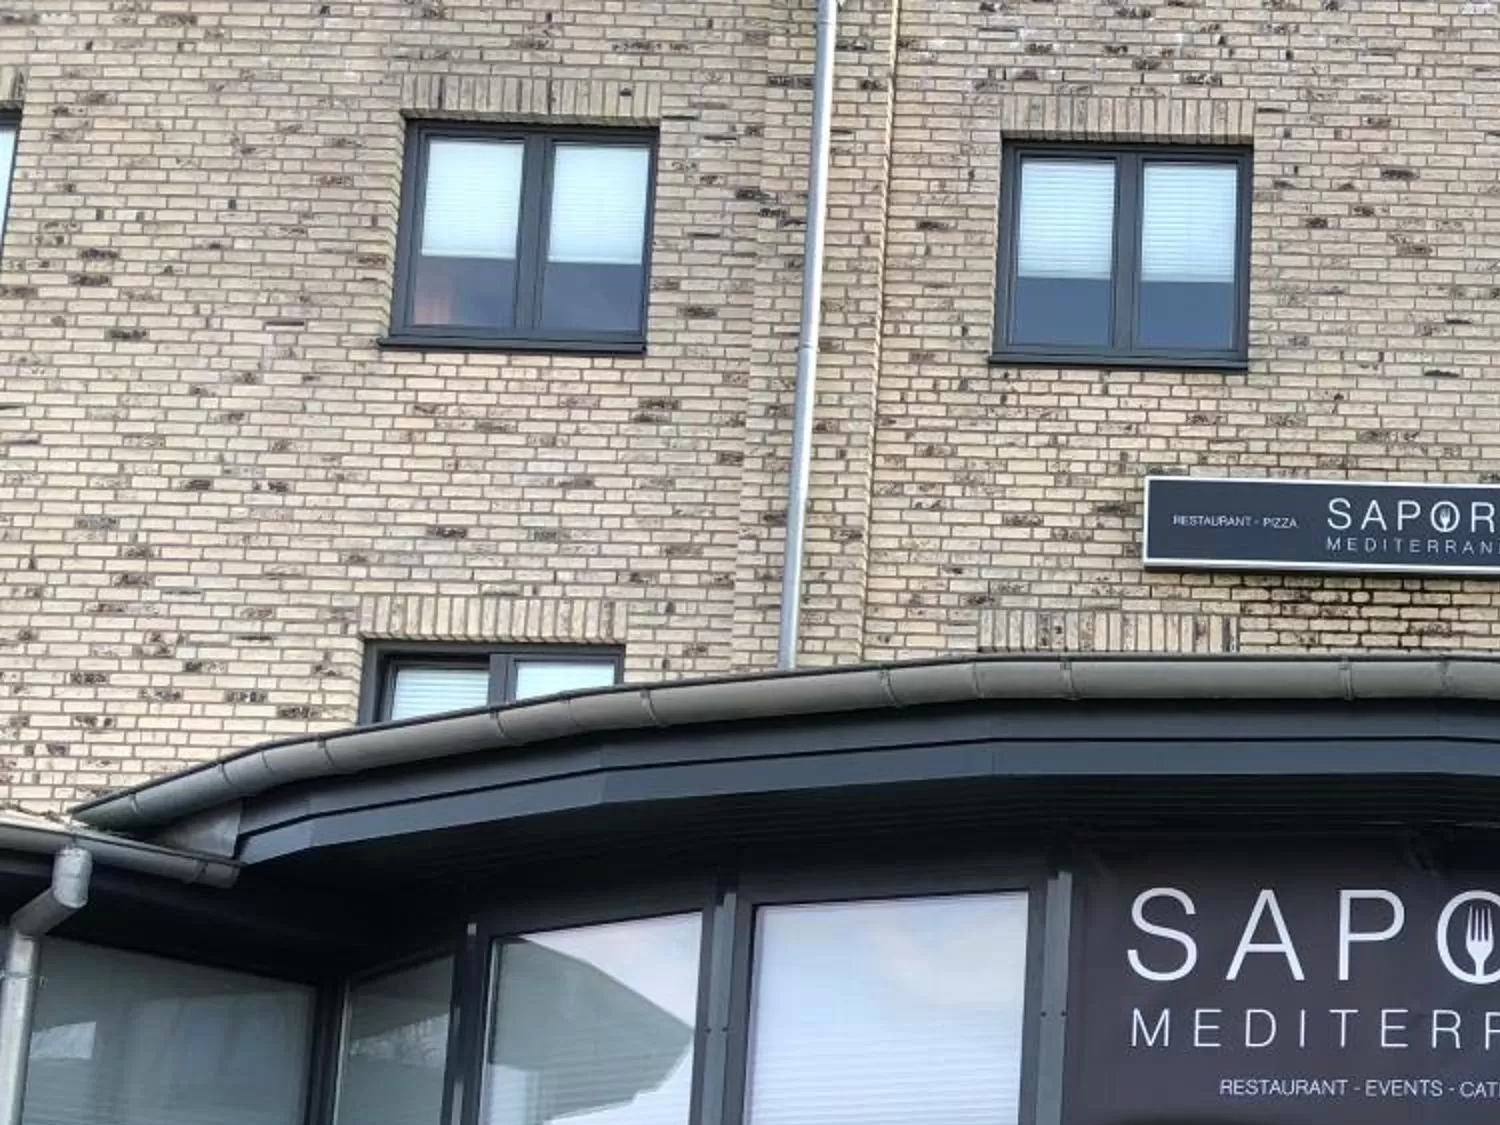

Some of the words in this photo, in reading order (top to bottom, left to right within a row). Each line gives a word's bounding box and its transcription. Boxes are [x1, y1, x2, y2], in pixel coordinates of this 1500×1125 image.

[1172, 515, 1252, 527] RESTAURANT
[1263, 517, 1300, 529] PIZZA
[1219, 1079, 1349, 1096] RESTAURANT
[1365, 1079, 1443, 1097] EVENTS
